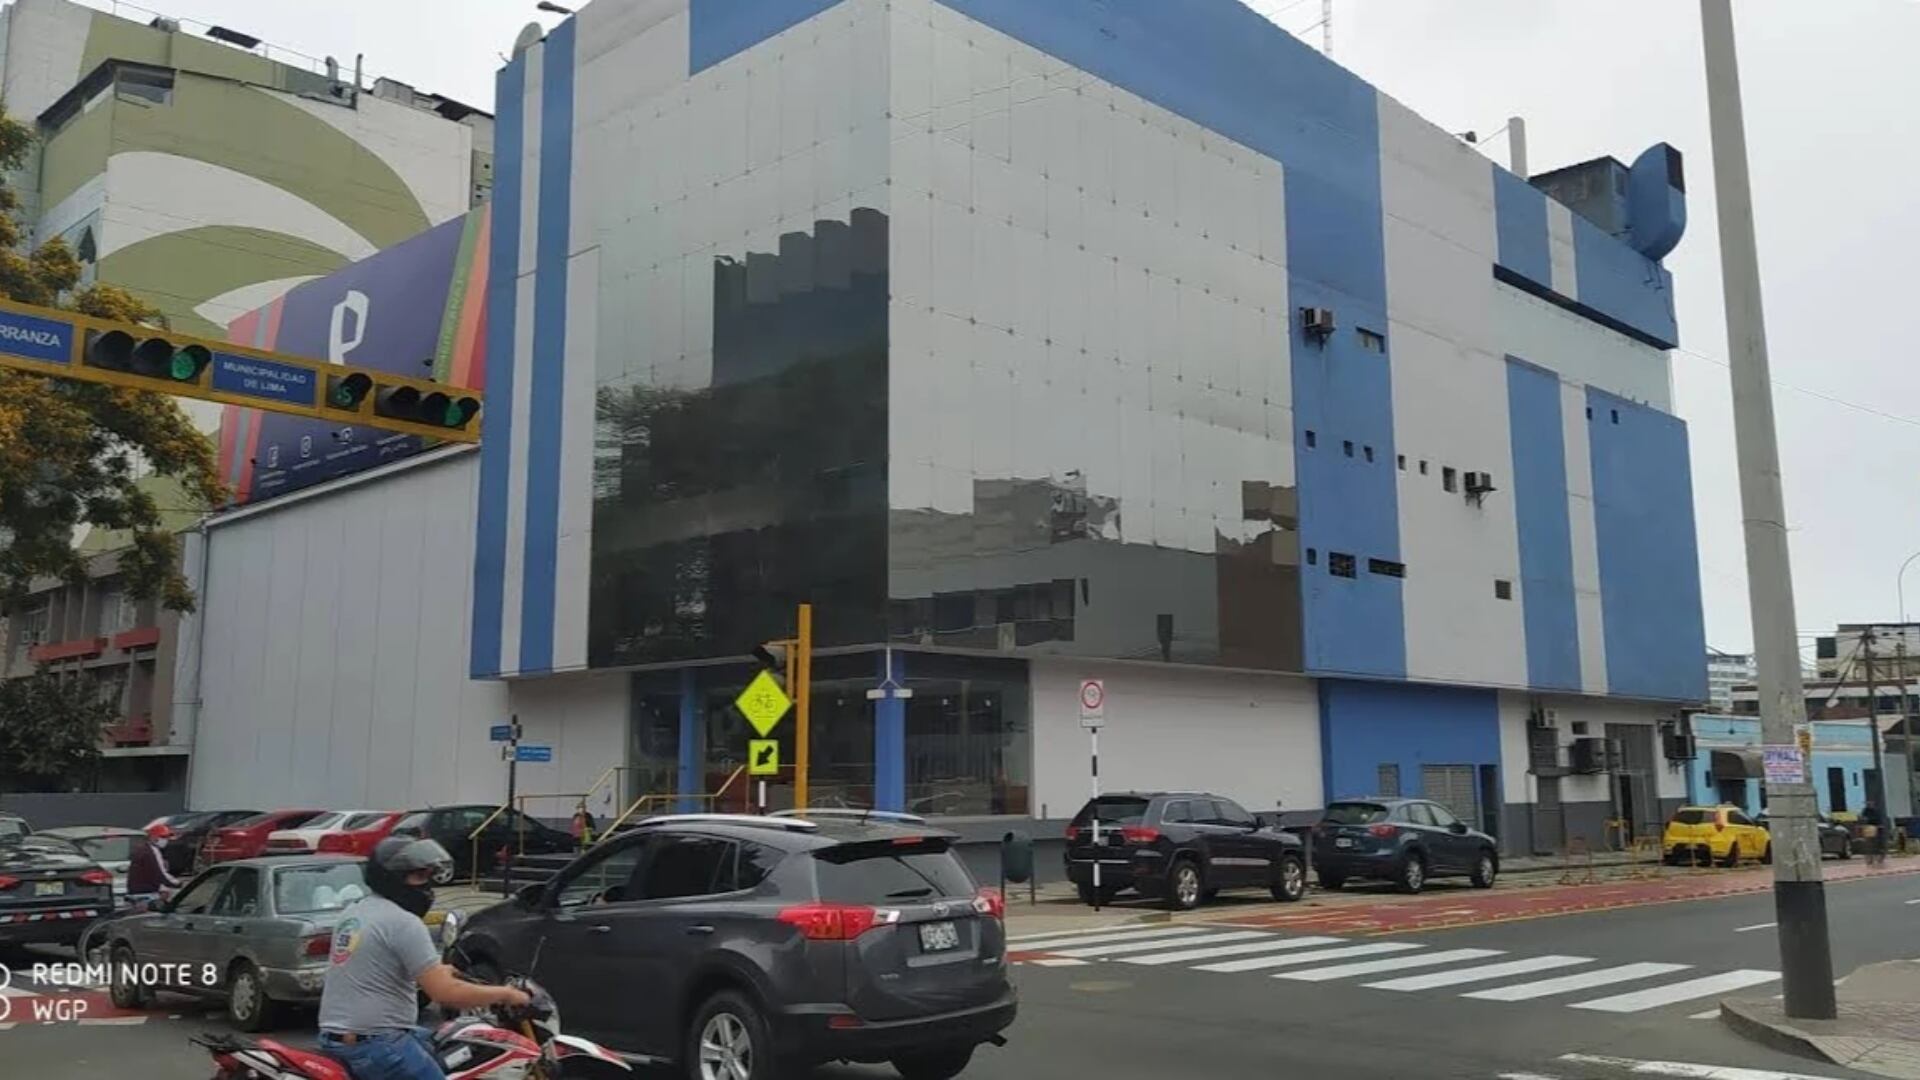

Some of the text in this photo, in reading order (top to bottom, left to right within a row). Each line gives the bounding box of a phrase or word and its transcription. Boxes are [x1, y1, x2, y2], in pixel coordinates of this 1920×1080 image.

[223, 361, 307, 384] MUNICIPALIDAD
[243, 379, 287, 393] DE LIMA
